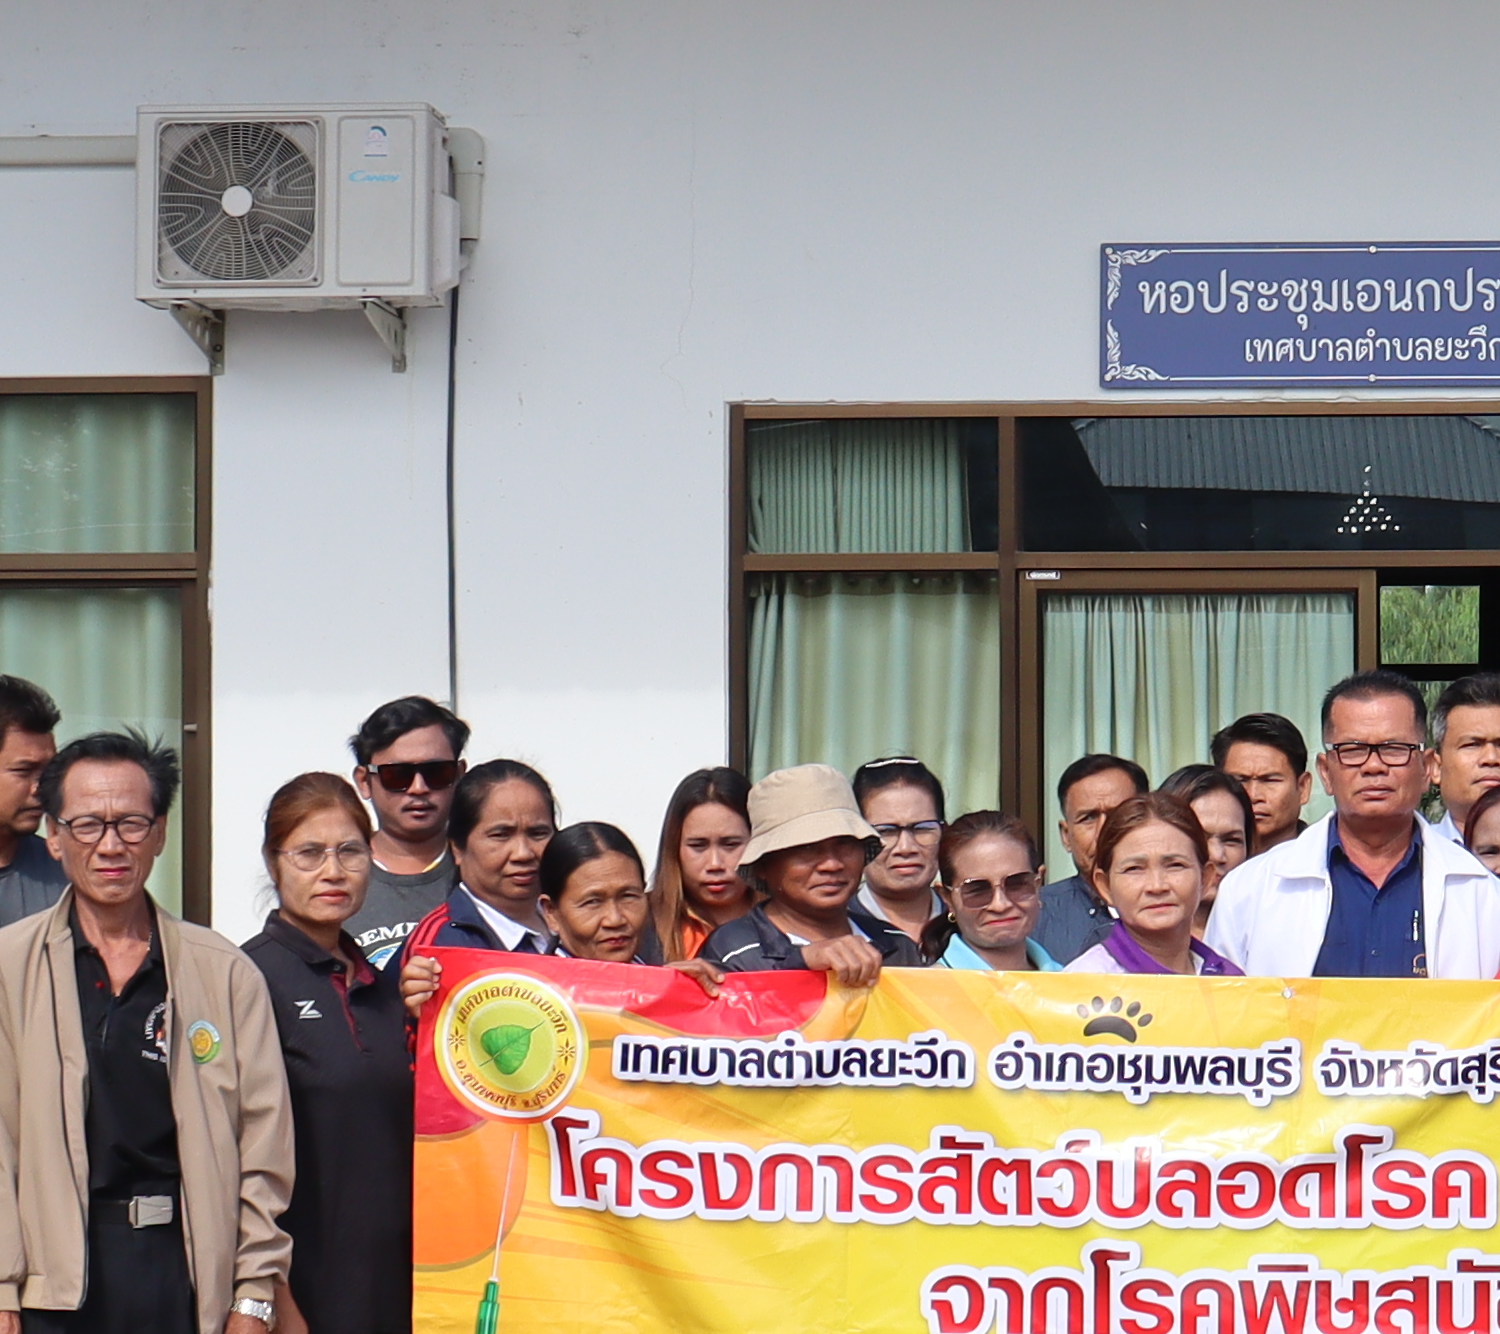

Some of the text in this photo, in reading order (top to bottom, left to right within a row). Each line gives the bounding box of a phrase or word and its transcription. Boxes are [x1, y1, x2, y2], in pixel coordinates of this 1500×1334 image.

[619, 1033, 968, 1081] เทศบาลตำบลยะวึก
[998, 1035, 1294, 1099] อำเภอชุมพลบุรี
[551, 1115, 1488, 1219] โครงการสัตว์ปลอดโรค
